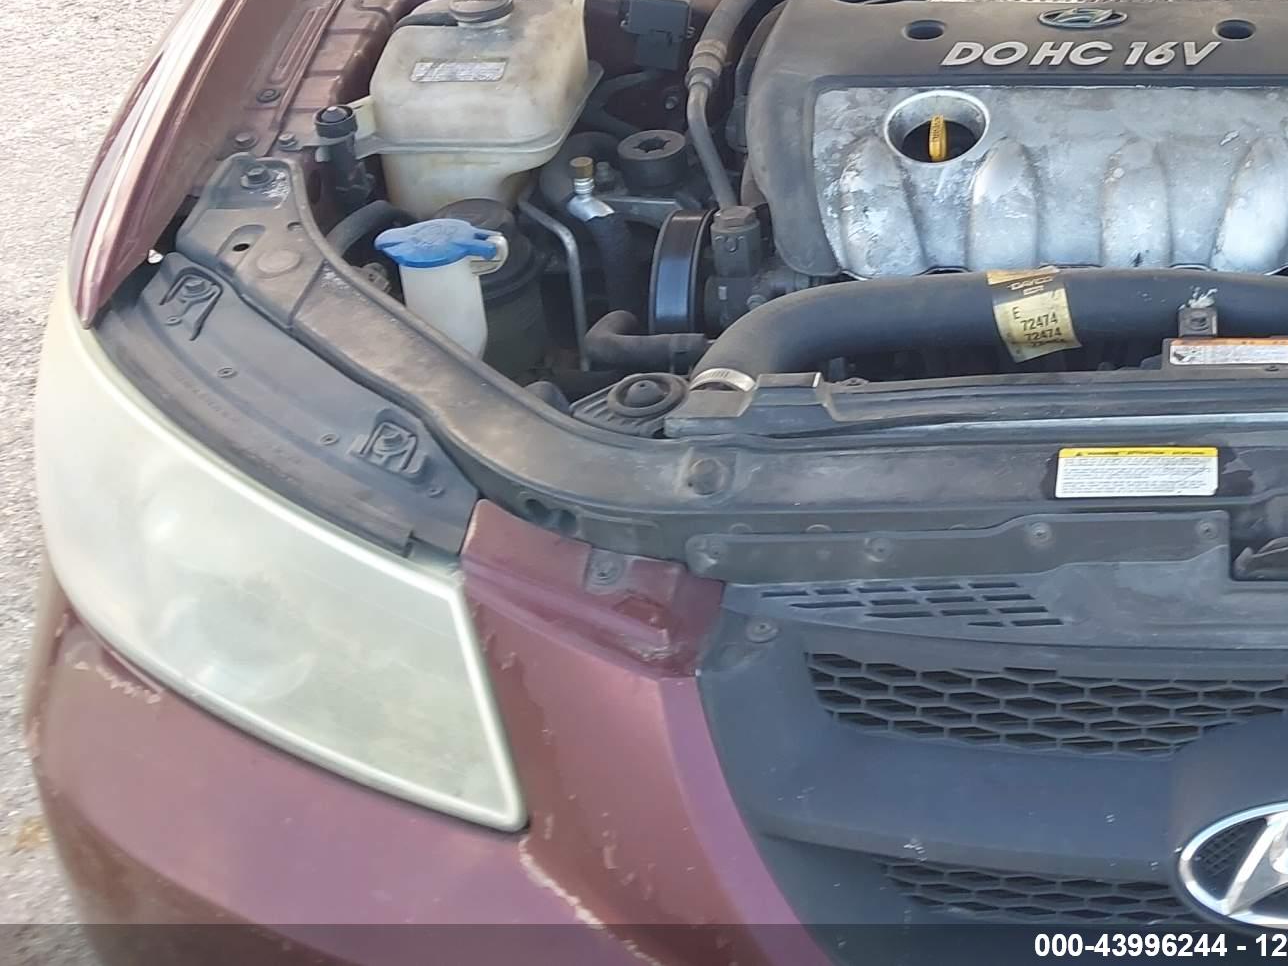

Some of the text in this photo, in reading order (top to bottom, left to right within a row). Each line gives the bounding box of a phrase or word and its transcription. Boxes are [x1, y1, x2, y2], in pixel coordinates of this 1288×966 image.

[940, 41, 1221, 66] DOHC 16V
[1012, 306, 1021, 320] E
[1020, 312, 1058, 331] 72474
